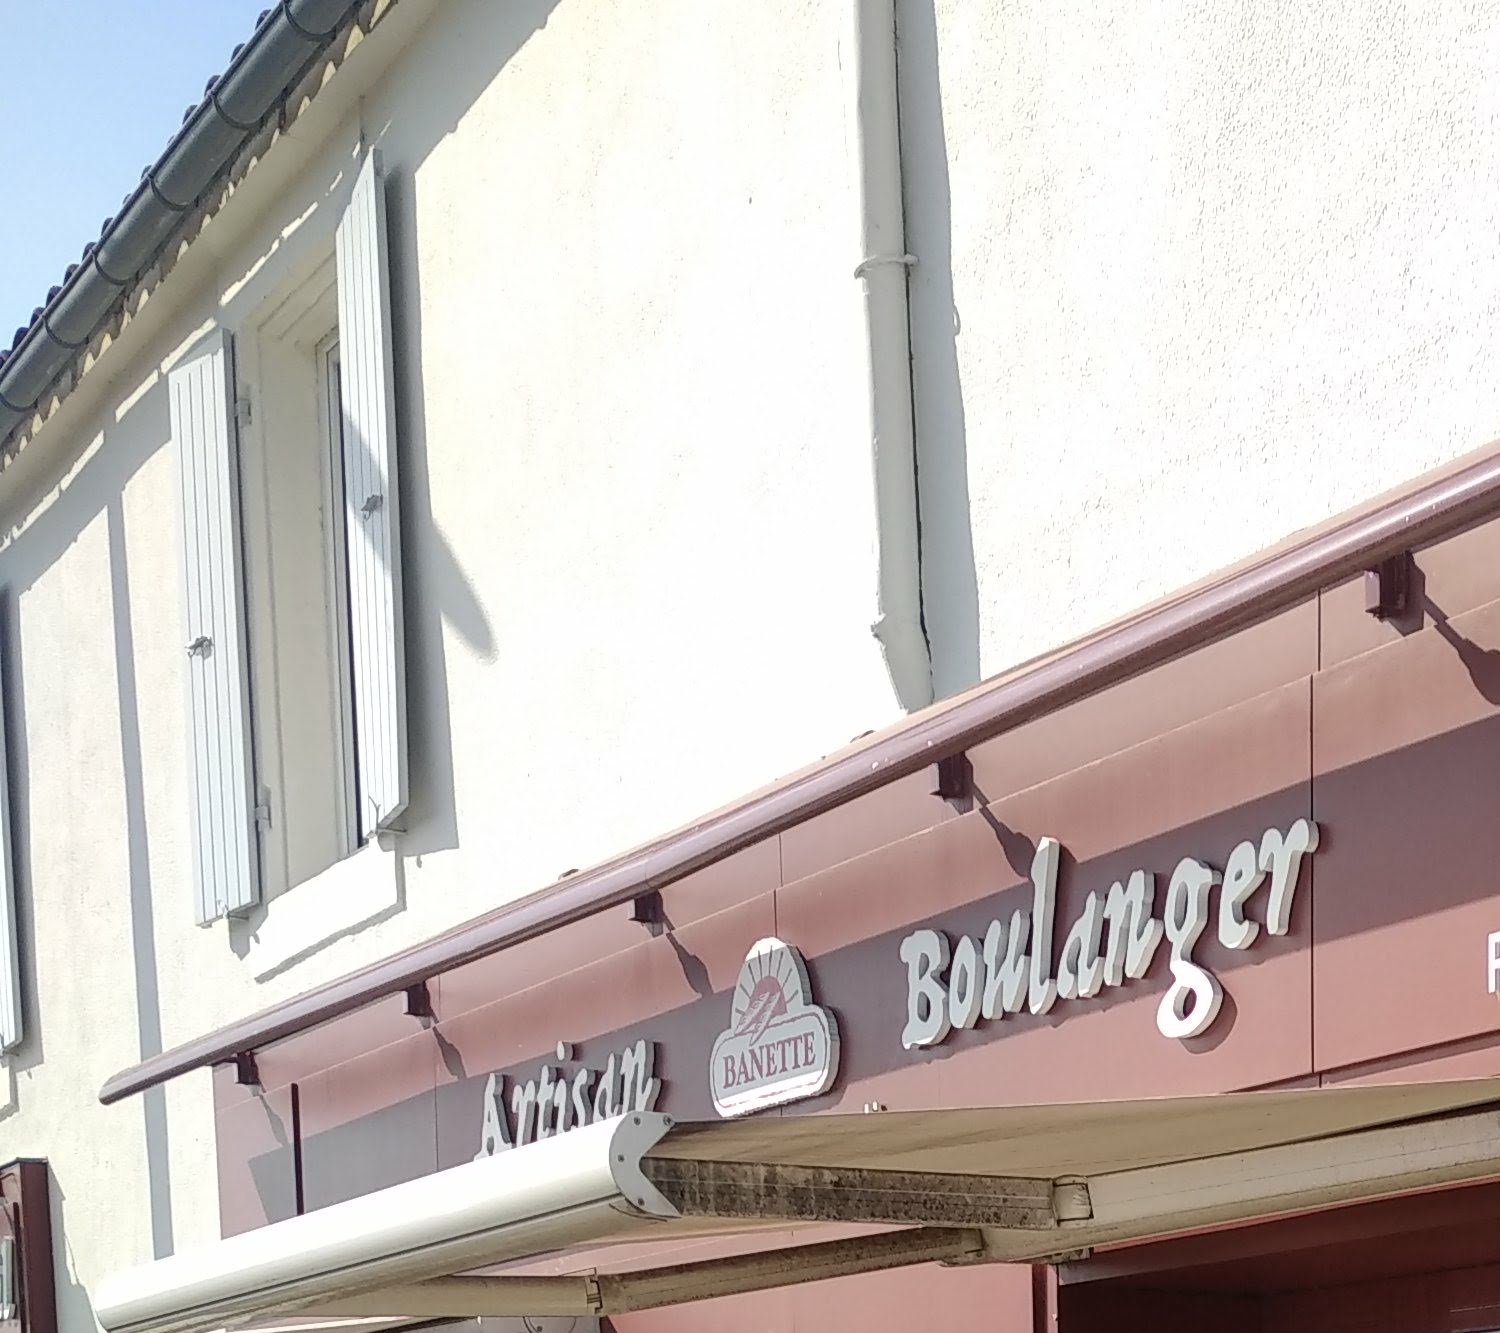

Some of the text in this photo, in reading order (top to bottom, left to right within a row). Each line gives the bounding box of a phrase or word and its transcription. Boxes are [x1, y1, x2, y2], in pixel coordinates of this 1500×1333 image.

[474, 817, 1320, 1162] Artisan Boulanger
[721, 1030, 817, 1091] BANETTE
